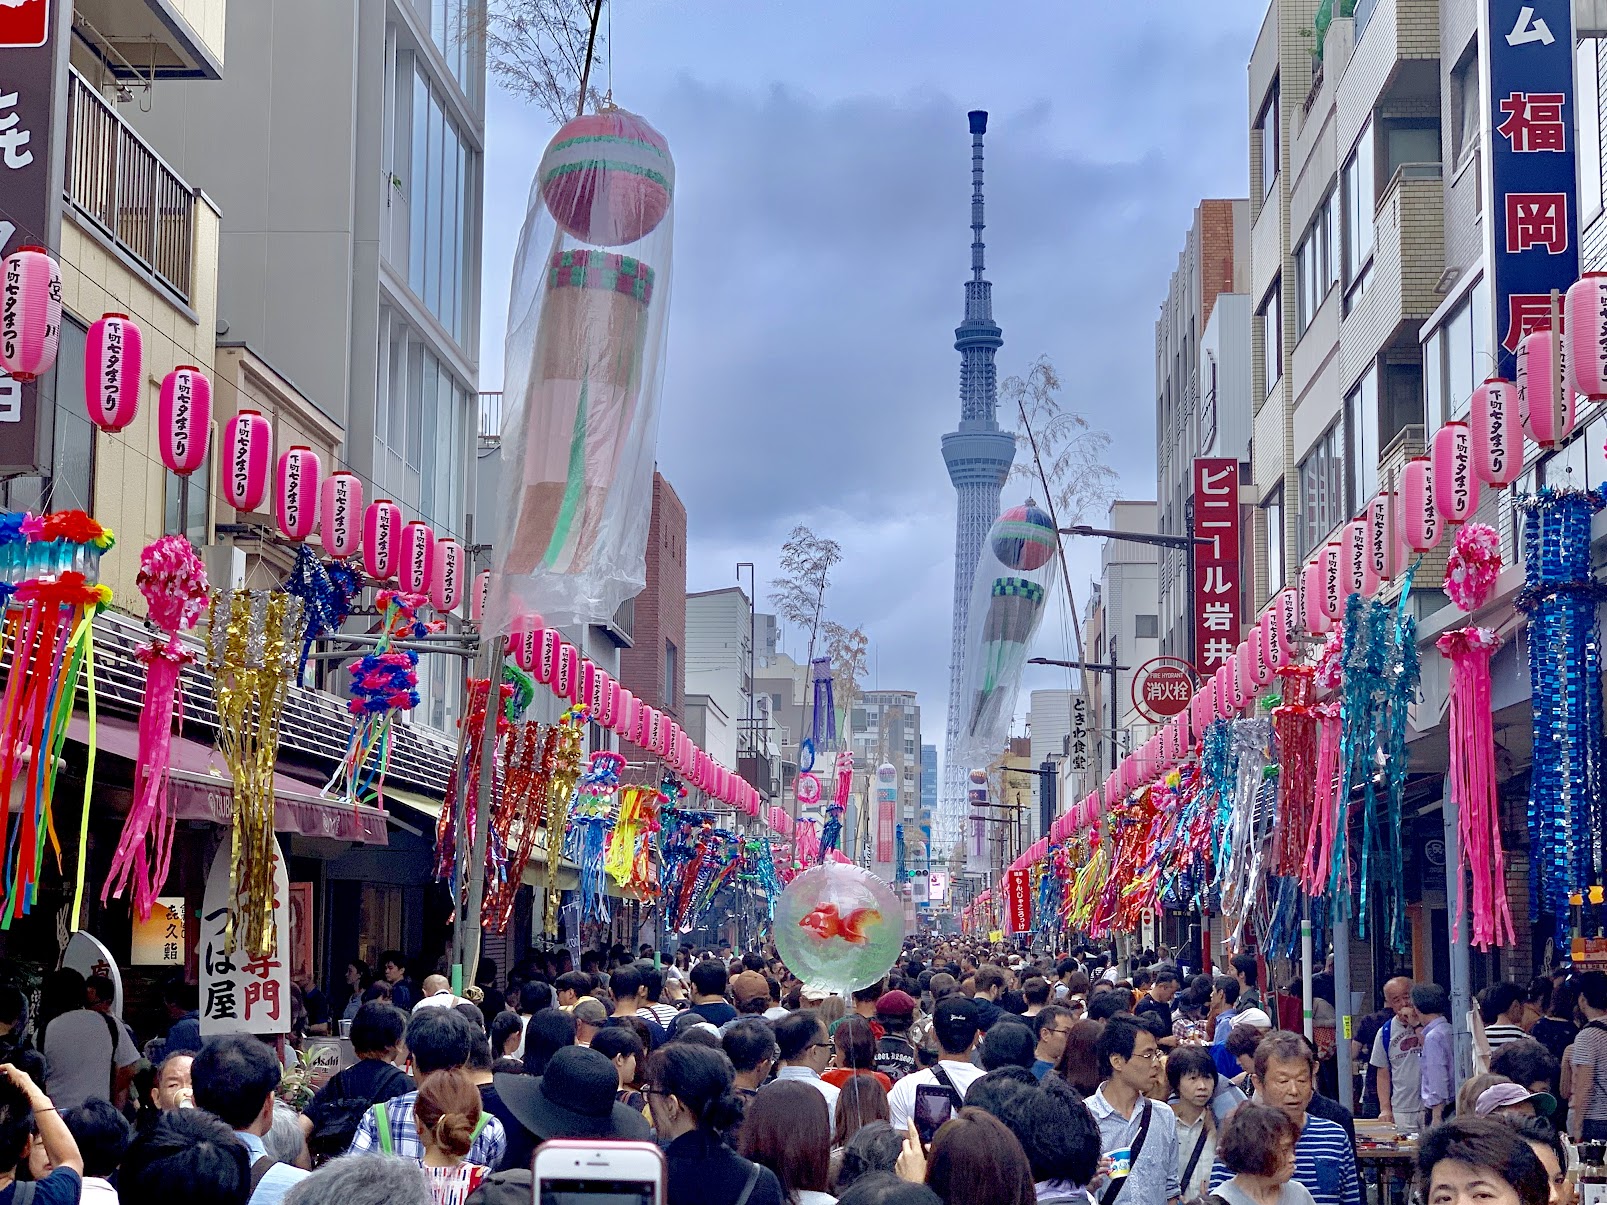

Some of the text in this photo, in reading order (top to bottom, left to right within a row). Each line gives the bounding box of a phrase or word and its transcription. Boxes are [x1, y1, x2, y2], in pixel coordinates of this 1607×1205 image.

[3, 259, 21, 359] 下町七夕まつり
[103, 322, 121, 411] 下町七夕まつり
[174, 374, 190, 456] 下町七夕まつり
[1490, 390, 1504, 472] 下町七夕まつり
[235, 420, 249, 496] 下町七夕まつり
[287, 455, 299, 526] 下町七夕まつり
[1455, 435, 1468, 511] 下町七夕まつり
[335, 481, 346, 547] 下町七夕まつり
[378, 509, 389, 570] 下町七夕まつり
[1374, 504, 1384, 571] 下町七夕まつり
[414, 529, 425, 587] 下町七夕まつり
[445, 547, 455, 604] 下町七夕まつり
[1202, 465, 1234, 666] ビニール岩井
[1328, 553, 1337, 612] 下町七夕まつり
[1353, 528, 1363, 589] 下町七夕まつり
[1147, 681, 1188, 700] 消火栓
[1072, 698, 1086, 769] ときわ食堂
[313, 1056, 338, 1066] Asahi
